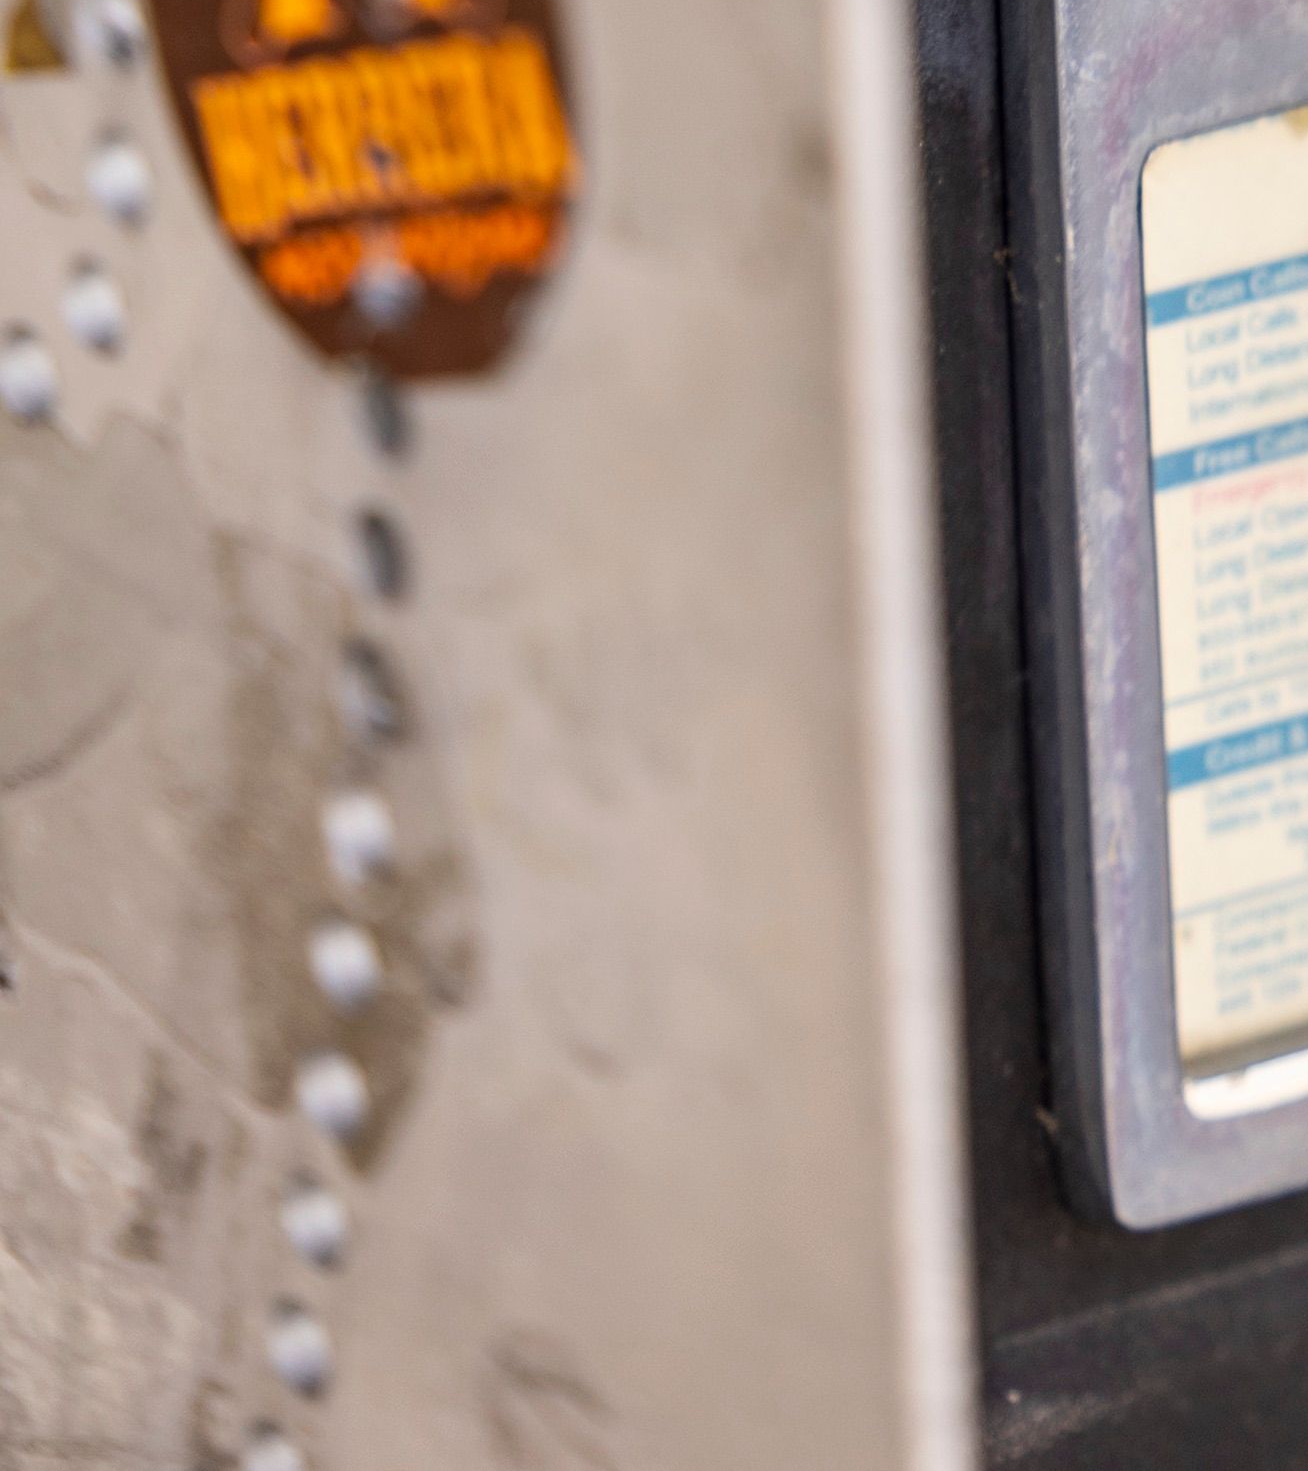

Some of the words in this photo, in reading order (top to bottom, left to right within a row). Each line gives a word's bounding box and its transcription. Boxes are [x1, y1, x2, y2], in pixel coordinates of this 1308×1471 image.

[1186, 318, 1241, 355] Local
[1248, 302, 1298, 339] Calls
[1187, 354, 1239, 395] Long
[1193, 438, 1249, 477] Free
[1195, 511, 1252, 553] Local
[1196, 552, 1246, 592] Long
[1197, 584, 1252, 624] Long
